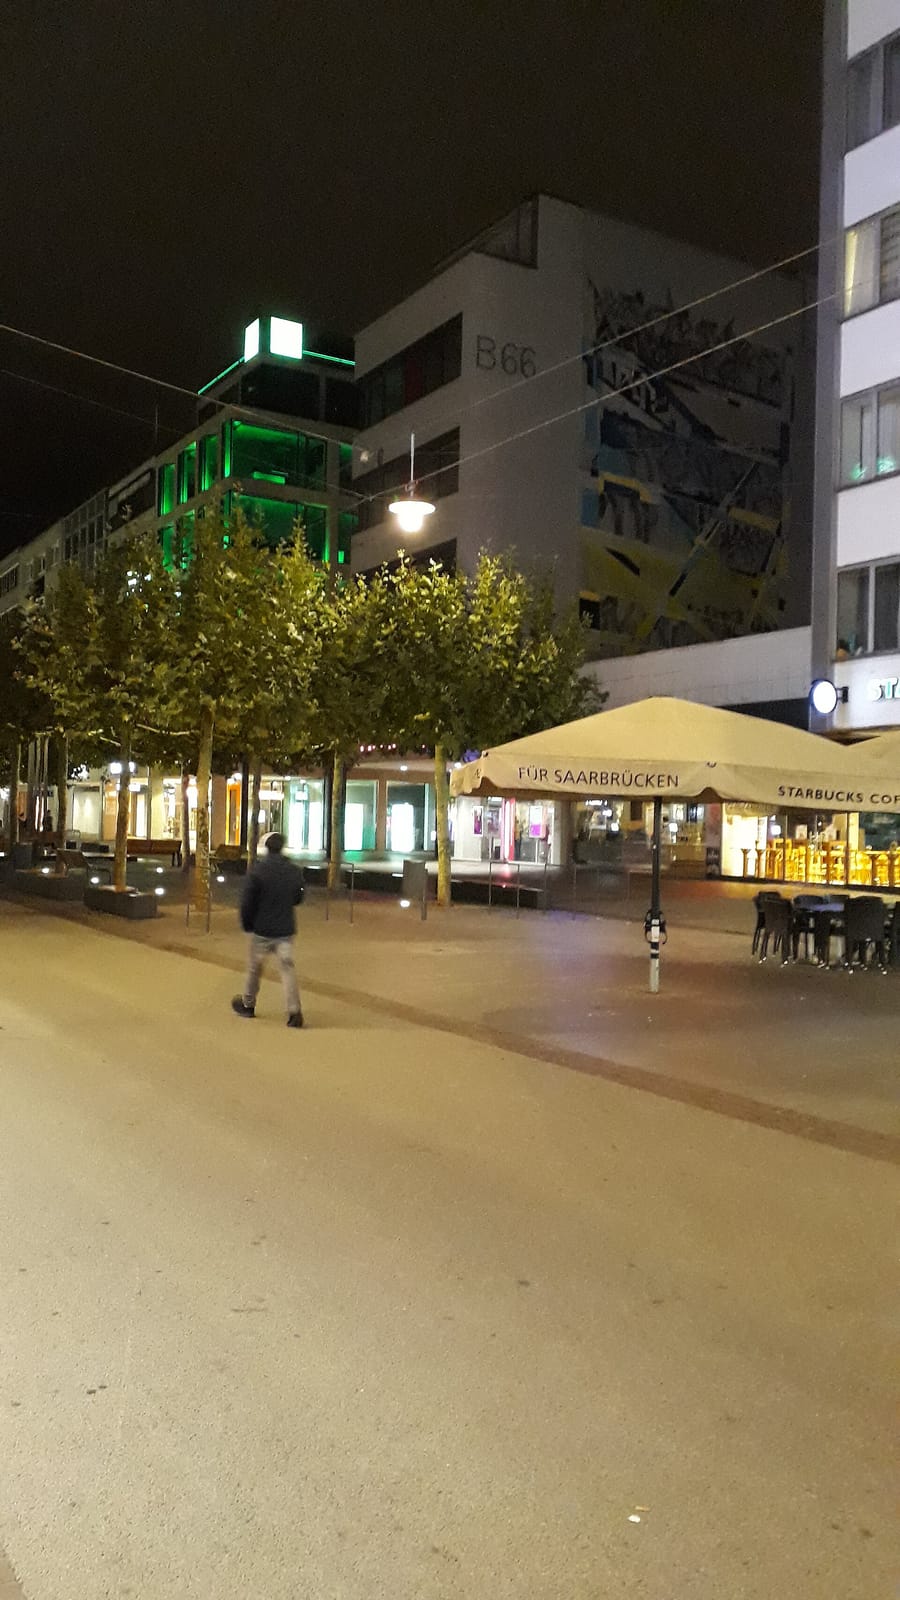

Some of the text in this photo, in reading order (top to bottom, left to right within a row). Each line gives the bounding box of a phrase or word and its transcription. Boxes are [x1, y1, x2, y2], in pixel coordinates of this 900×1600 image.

[476, 335, 537, 378] B66
[518, 764, 679, 788] FÜR SAARBRÜCKEN
[778, 785, 863, 803] STARBUCKS
